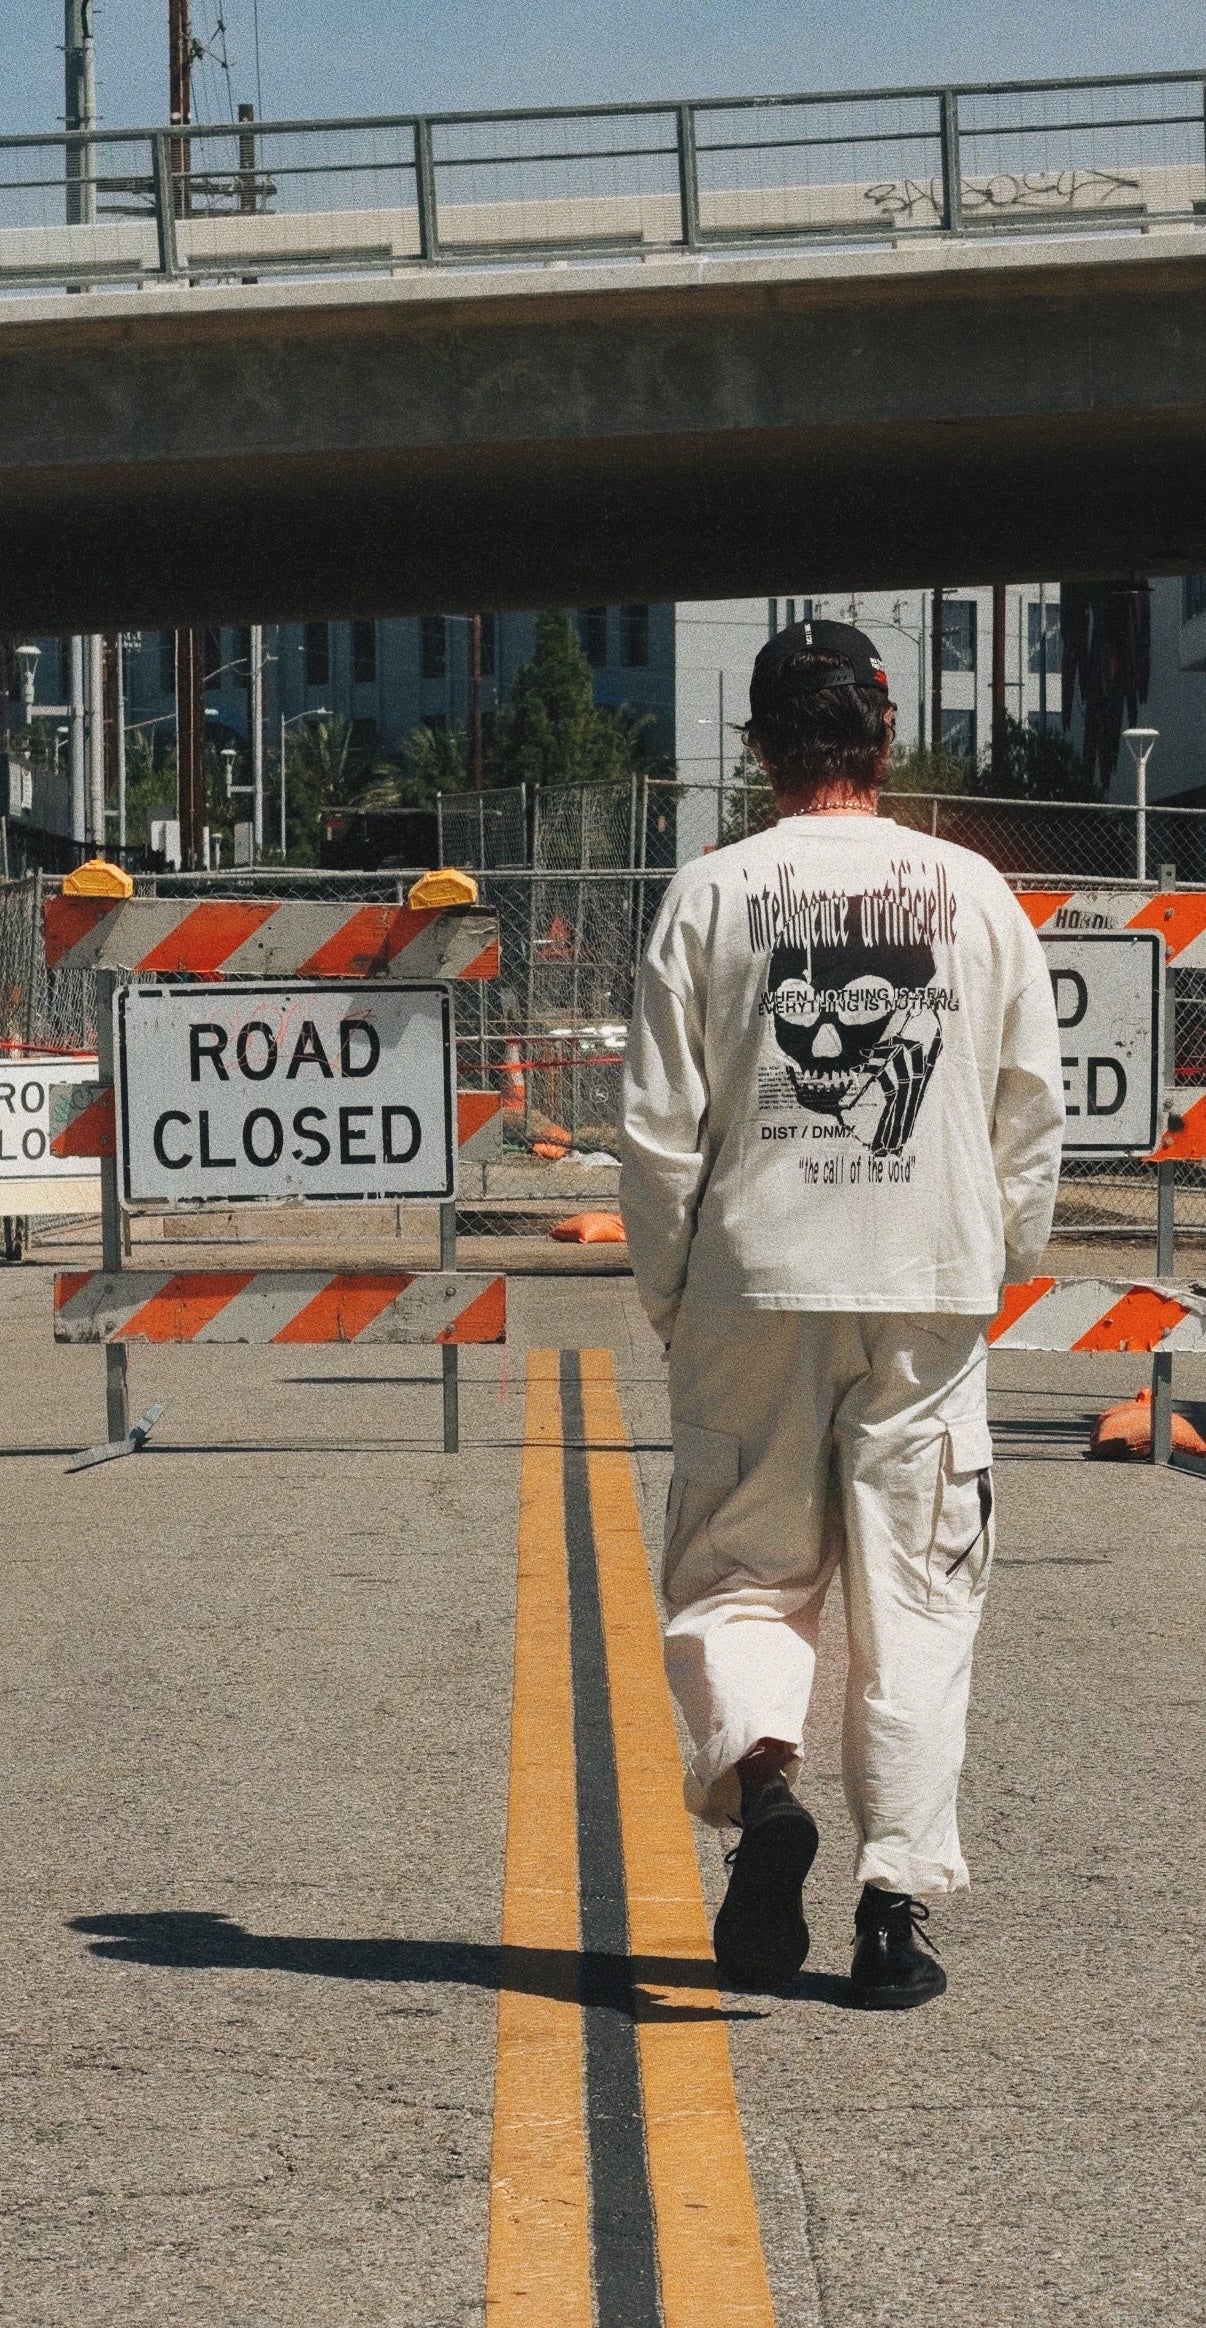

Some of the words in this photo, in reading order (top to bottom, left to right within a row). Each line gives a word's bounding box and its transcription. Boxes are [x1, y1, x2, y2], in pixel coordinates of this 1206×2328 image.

[743, 862, 849, 953] intelligence
[861, 860, 957, 948] artificielle
[759, 1001, 859, 1016] EVERYTHING
[865, 1000, 880, 1012] IS
[814, 987, 889, 1003] NOTHING
[189, 1019, 381, 1083] ROAD
[152, 1106, 422, 1170] CLOSED
[761, 1125, 798, 1140] DIST
[812, 1125, 856, 1138] DNMX
[823, 1156, 844, 1184] call
[850, 1156, 861, 1184] of
[868, 1156, 883, 1183] the
